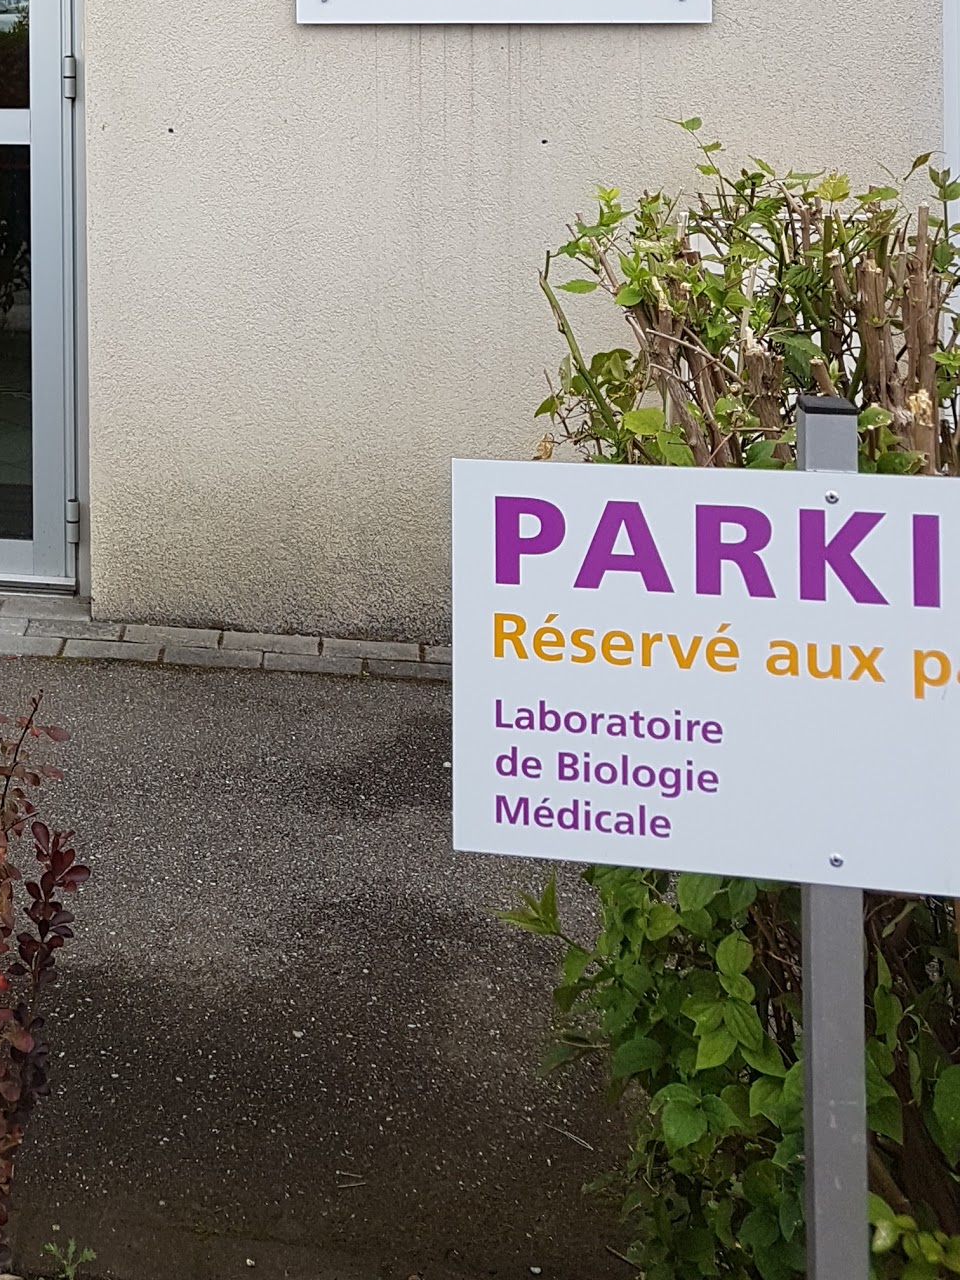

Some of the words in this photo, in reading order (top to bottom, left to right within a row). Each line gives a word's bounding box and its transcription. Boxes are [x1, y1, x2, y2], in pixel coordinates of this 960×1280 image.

[495, 496, 940, 608] PARKI
[494, 613, 739, 672] Réservé
[766, 640, 885, 682] aux
[914, 650, 960, 699] p
[496, 700, 723, 743] Laboratoire
[496, 746, 542, 778] de
[559, 752, 718, 798] Biologie
[496, 795, 671, 838] Médicale
